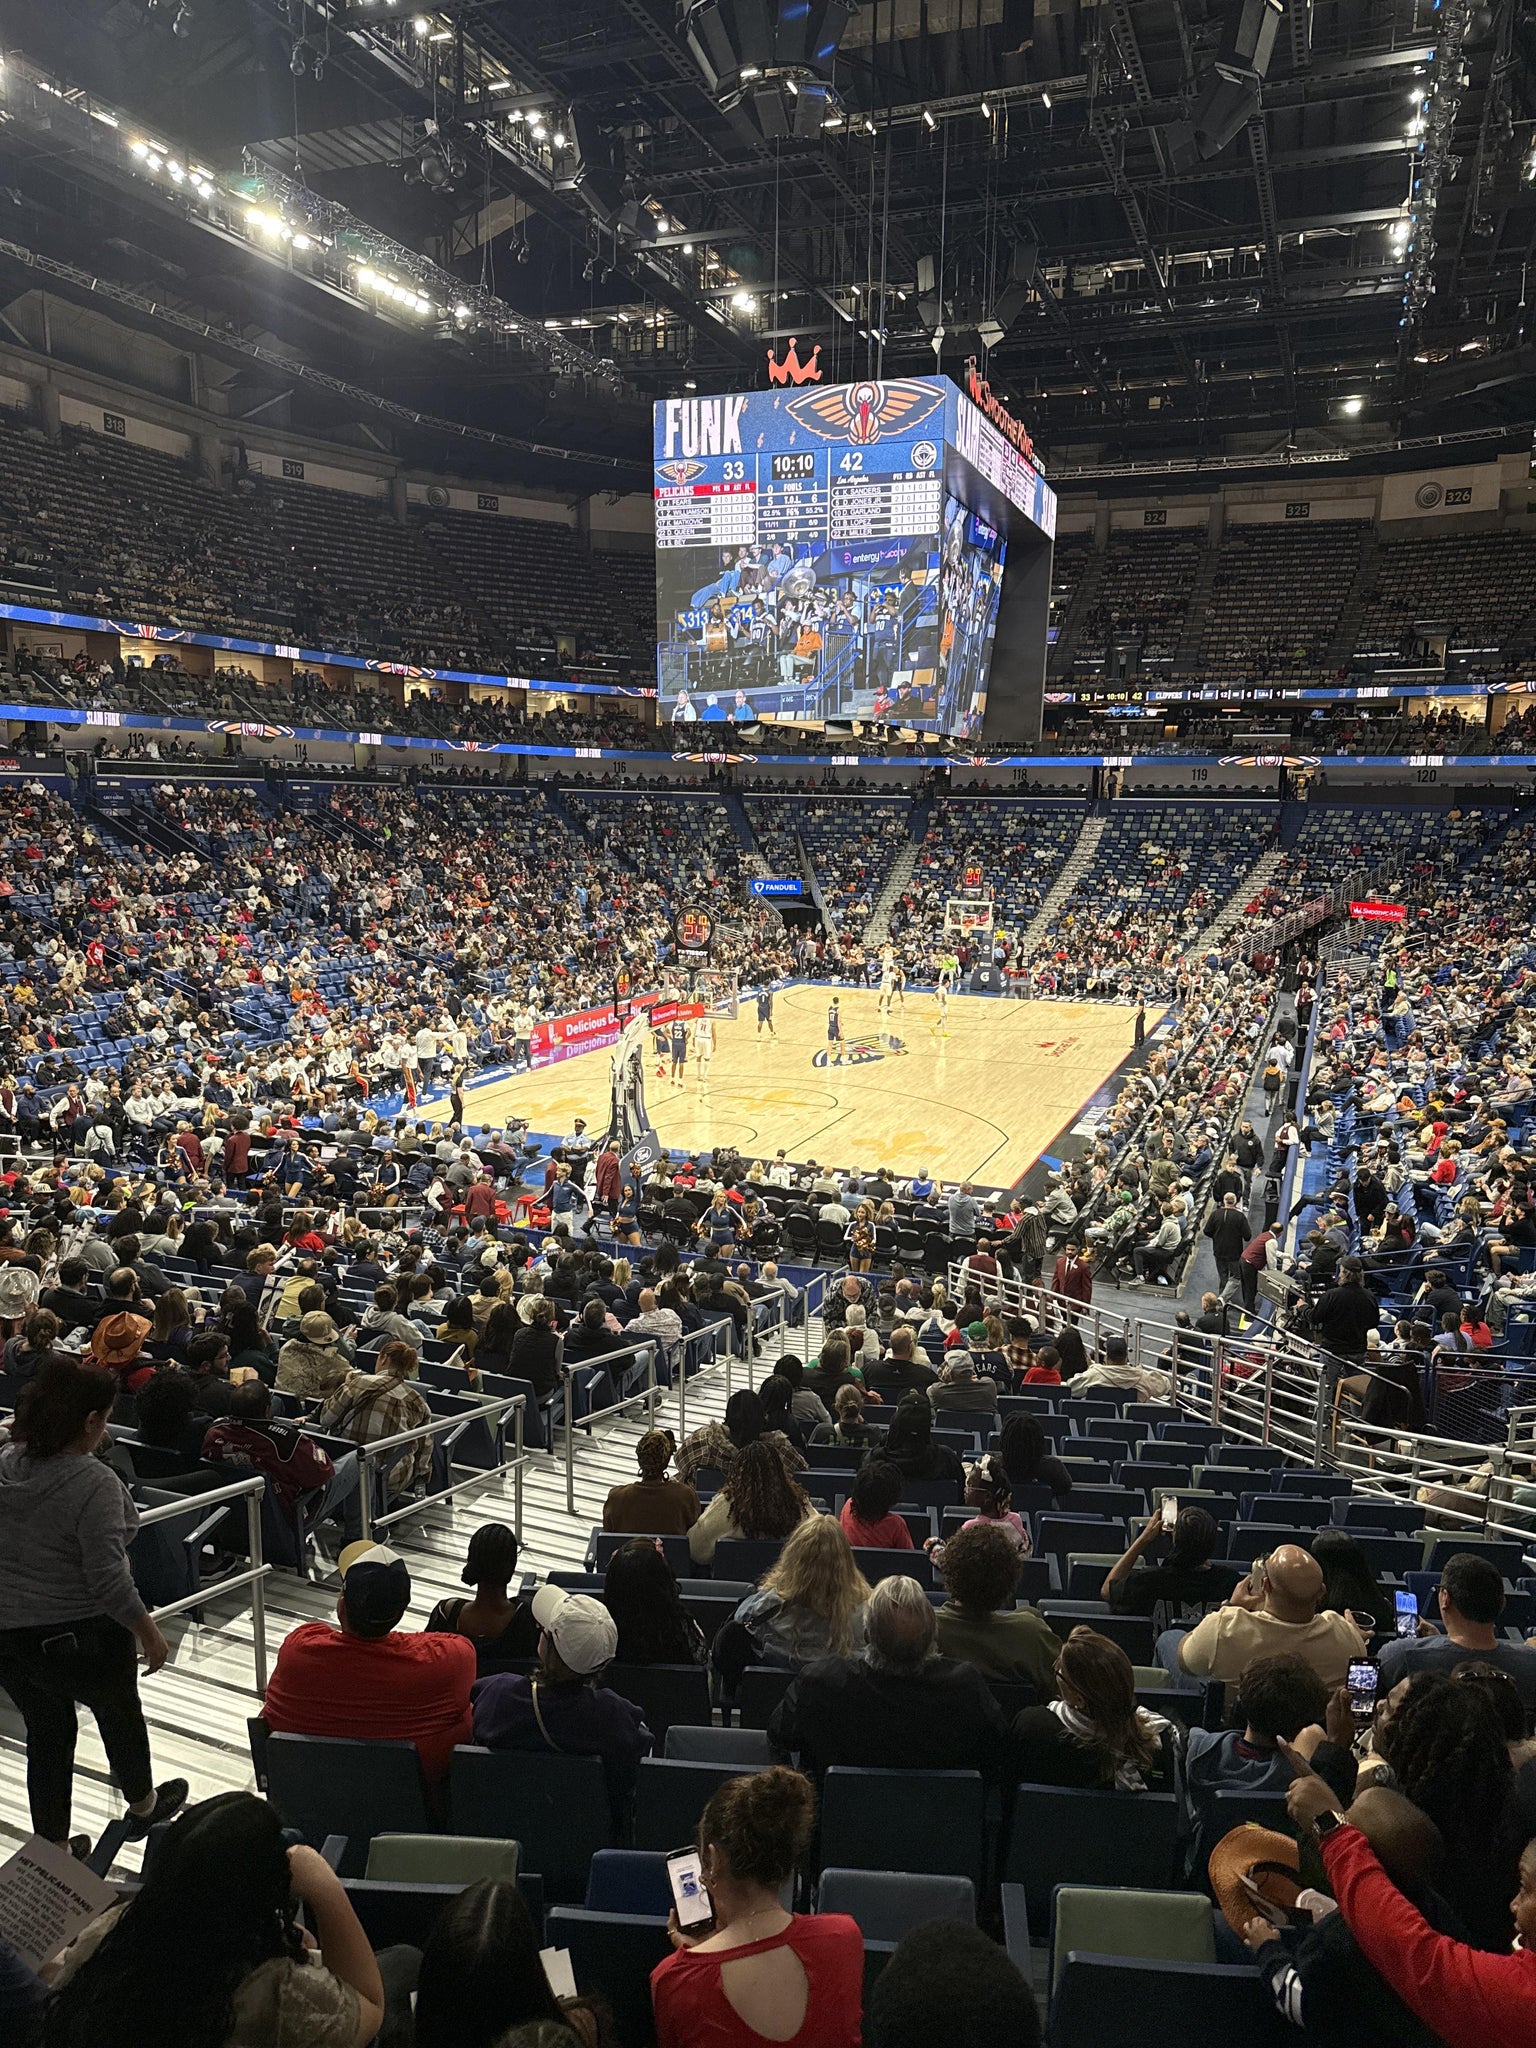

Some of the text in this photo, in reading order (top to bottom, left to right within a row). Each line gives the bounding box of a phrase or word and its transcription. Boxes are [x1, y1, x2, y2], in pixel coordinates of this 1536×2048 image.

[105, 416, 124, 432] 318
[664, 396, 745, 458] FUNK
[1016, 419, 1034, 461] KING
[773, 454, 814, 472] 10:10
[839, 452, 863, 471] 42
[284, 463, 303, 476] 319
[723, 461, 745, 480] 33
[836, 476, 847, 484] Los
[847, 474, 869, 485] Angeles
[659, 486, 694, 498] PELICANS
[767, 481, 818, 493] 0 FOULS 1
[850, 487, 881, 495] SANDERS
[767, 496, 774, 506] 5
[811, 494, 818, 503] 6
[1446, 490, 1470, 503] 326
[478, 497, 498, 509] 320
[673, 507, 710, 515] WILLIAMSON
[1286, 505, 1309, 516] 325
[673, 518, 704, 526] MATKOVIC
[850, 518, 871, 526] LOPEZ
[1145, 512, 1165, 523] 324
[789, 520, 797, 528] FT
[849, 528, 872, 536] MILLER
[852, 552, 879, 564] entergy
[687, 610, 708, 628] 313
[1106, 693, 1125, 701] 10:10
[1131, 692, 1143, 700] 42
[1155, 691, 1182, 700] CLIPPERS
[1357, 687, 1373, 698] SLAM
[86, 711, 120, 727] SLAM FUNK
[294, 743, 307, 758] 114
[430, 752, 444, 766] 115
[1409, 755, 1444, 766] SLAM FUNK
[612, 761, 626, 774] 116
[823, 767, 836, 778] 117
[1013, 769, 1028, 780] 118
[1192, 768, 1208, 781] 119
[1417, 769, 1437, 782] 120
[685, 914, 708, 926] 10:10
[683, 924, 705, 943] 24
[686, 949, 708, 957] TISSOT
[980, 972, 989, 982] G
[566, 1017, 607, 1036] Delicious
[616, 1105, 624, 1138] NBA
[18, 1854, 36, 1870] HEY
[33, 1866, 72, 1895] PELICANS
